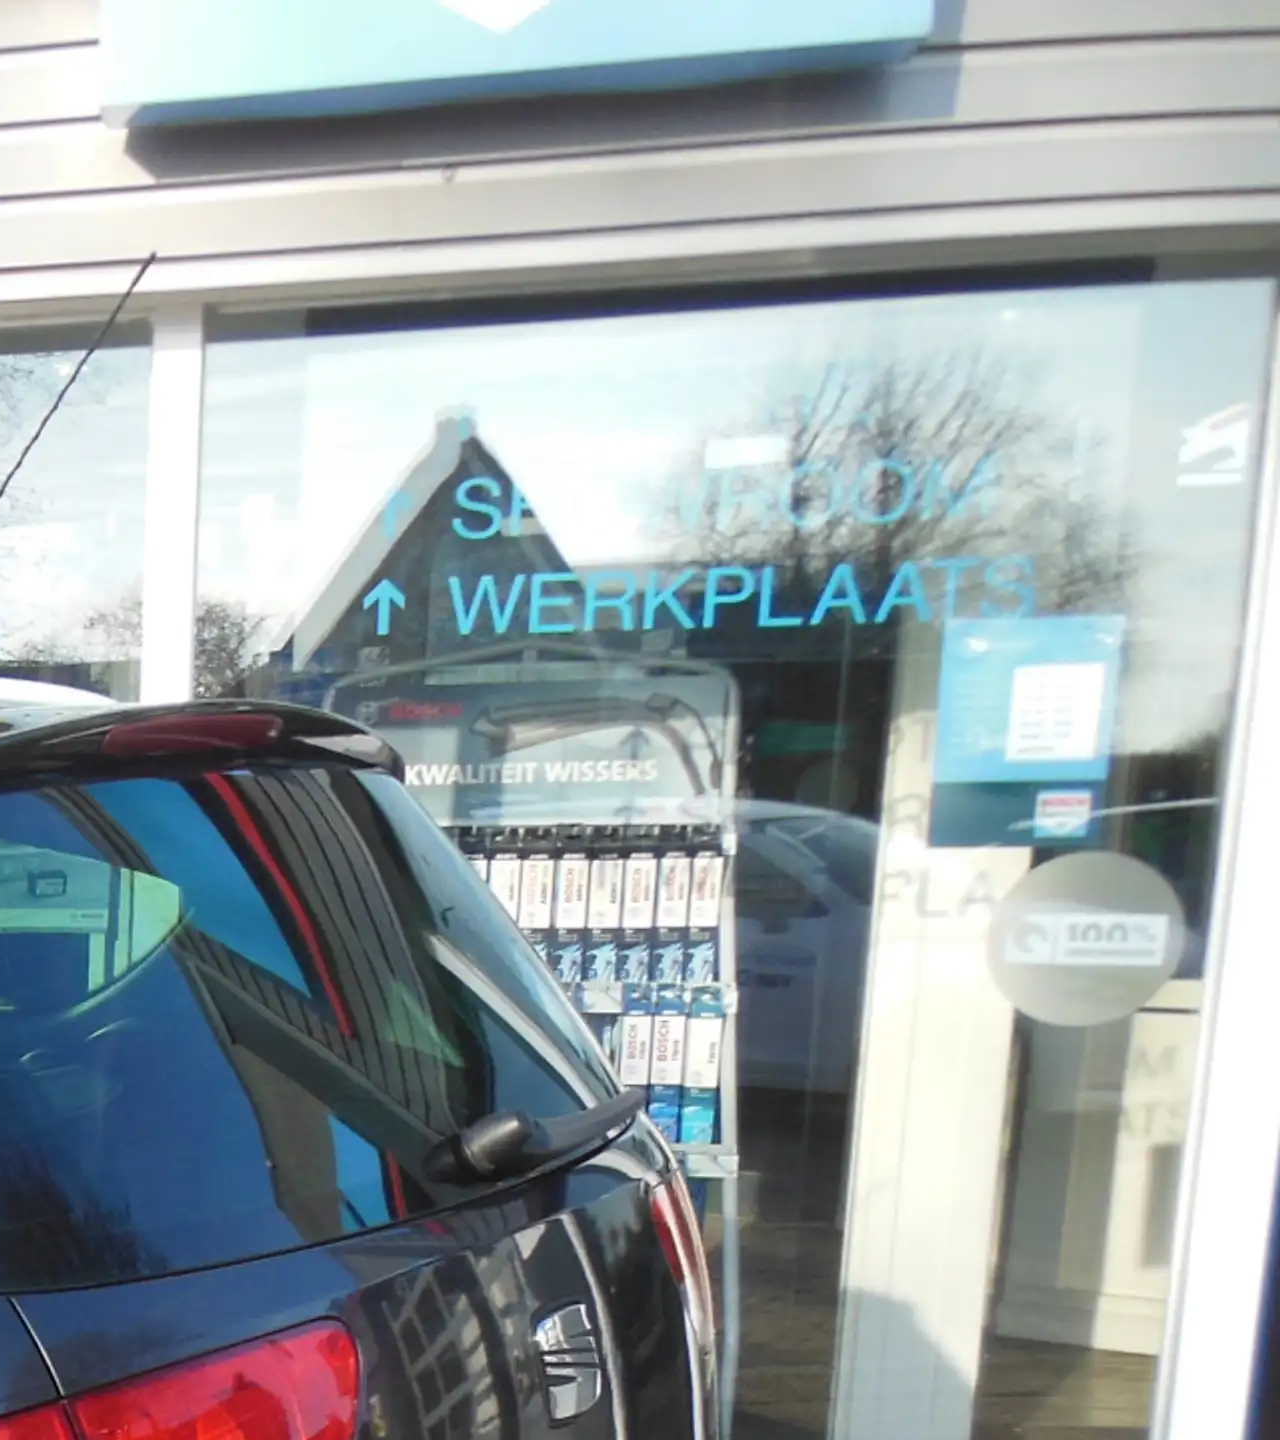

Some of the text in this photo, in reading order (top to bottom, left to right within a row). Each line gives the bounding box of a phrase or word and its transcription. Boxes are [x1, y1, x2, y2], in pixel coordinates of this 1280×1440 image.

[447, 555, 1036, 636] WERKPLAATS
[404, 759, 659, 786] KWALITEIT WISSERS
[656, 1019, 671, 1062] BOSCH
